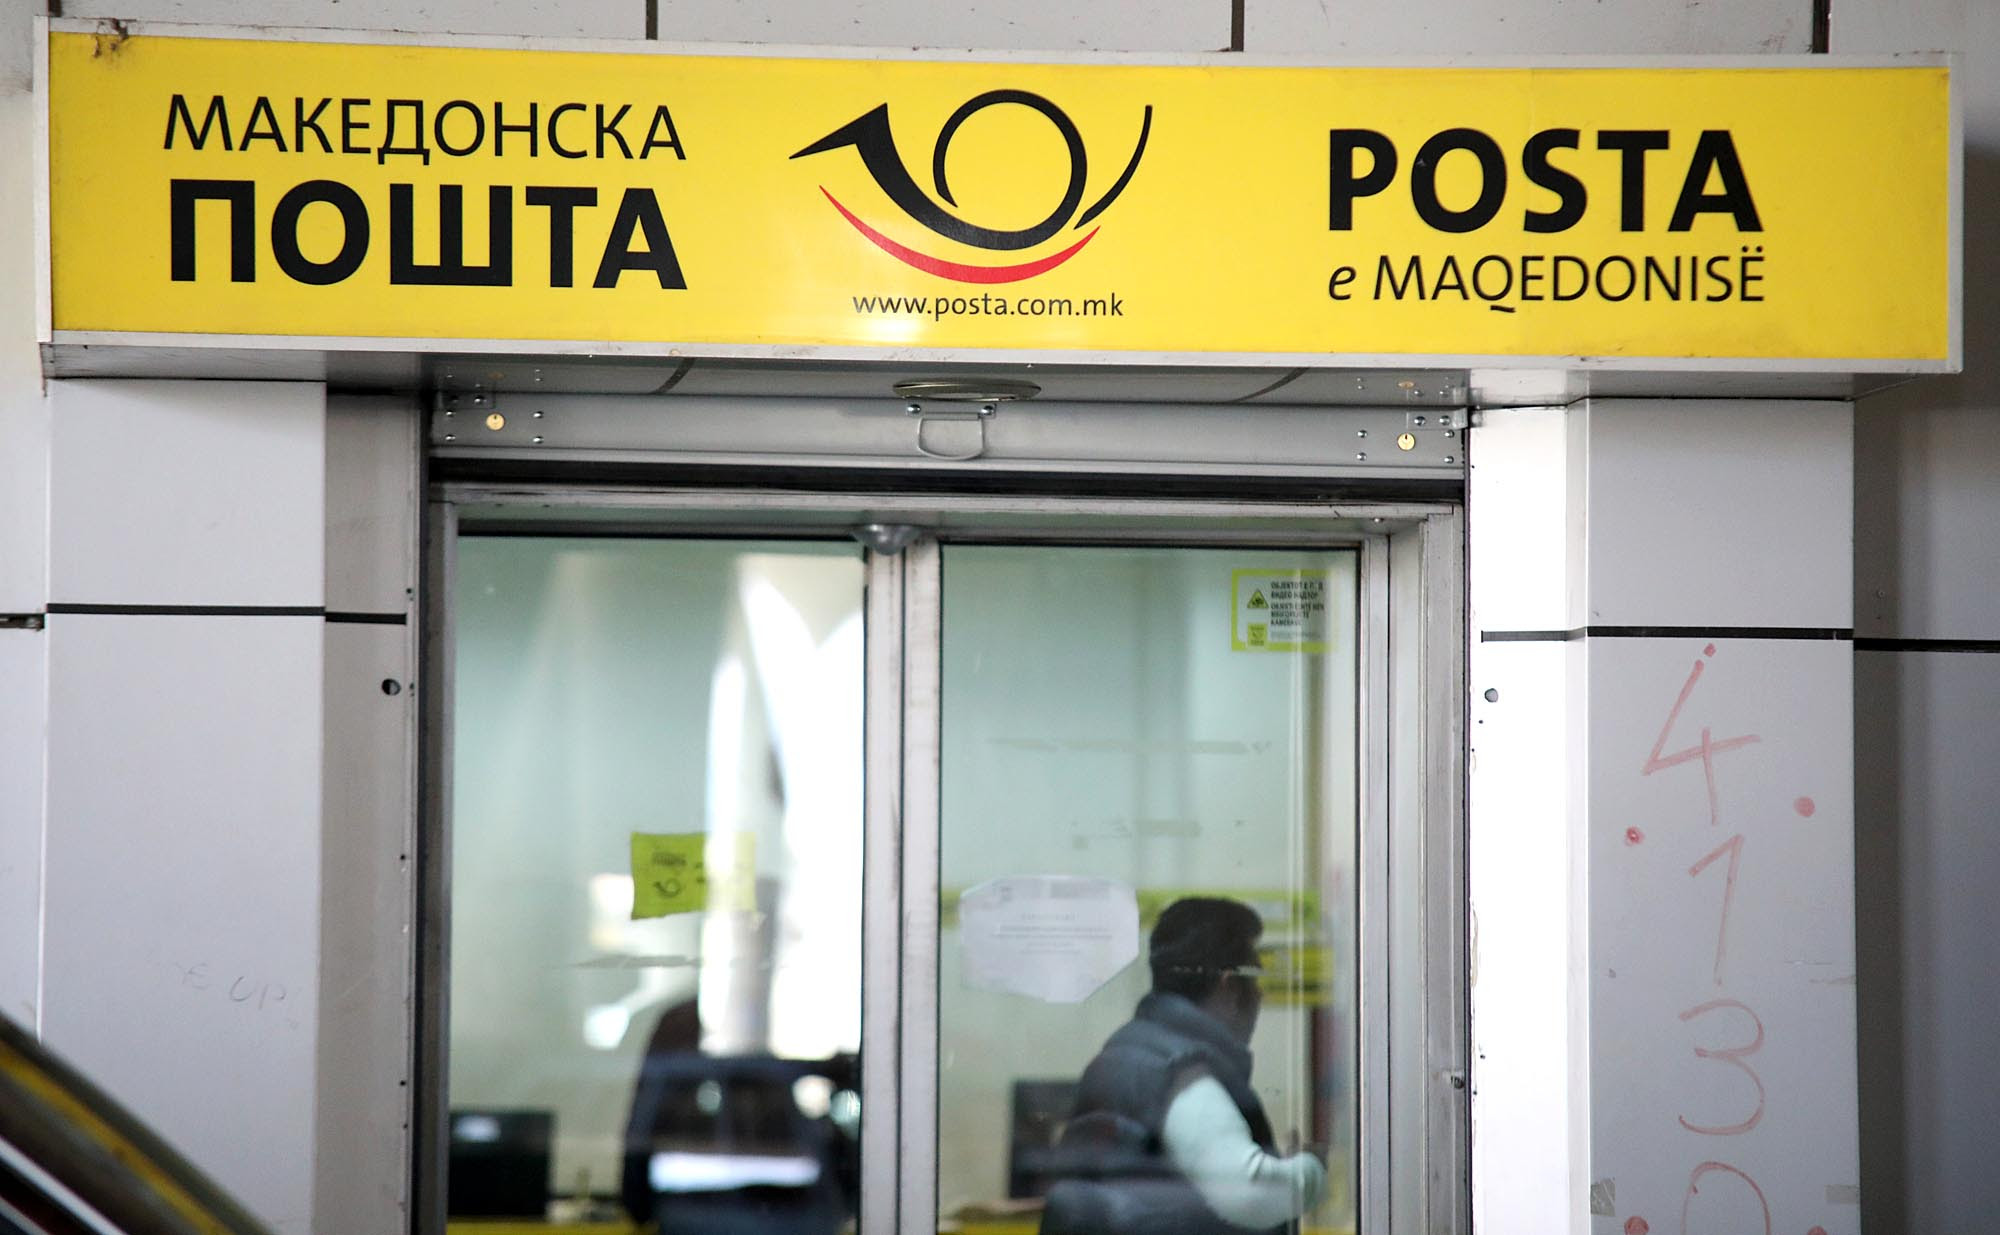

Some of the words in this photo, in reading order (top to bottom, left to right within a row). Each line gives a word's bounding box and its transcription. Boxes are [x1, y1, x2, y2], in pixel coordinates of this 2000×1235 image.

[163, 93, 687, 166] МАКЕДОНСКА
[1328, 127, 1764, 234] POSTA
[169, 178, 688, 290] ПОШТА
[852, 292, 1124, 322] www.posta.com.mk
[1328, 266, 1357, 301] e
[1373, 246, 1765, 313] MAQEDONISË
